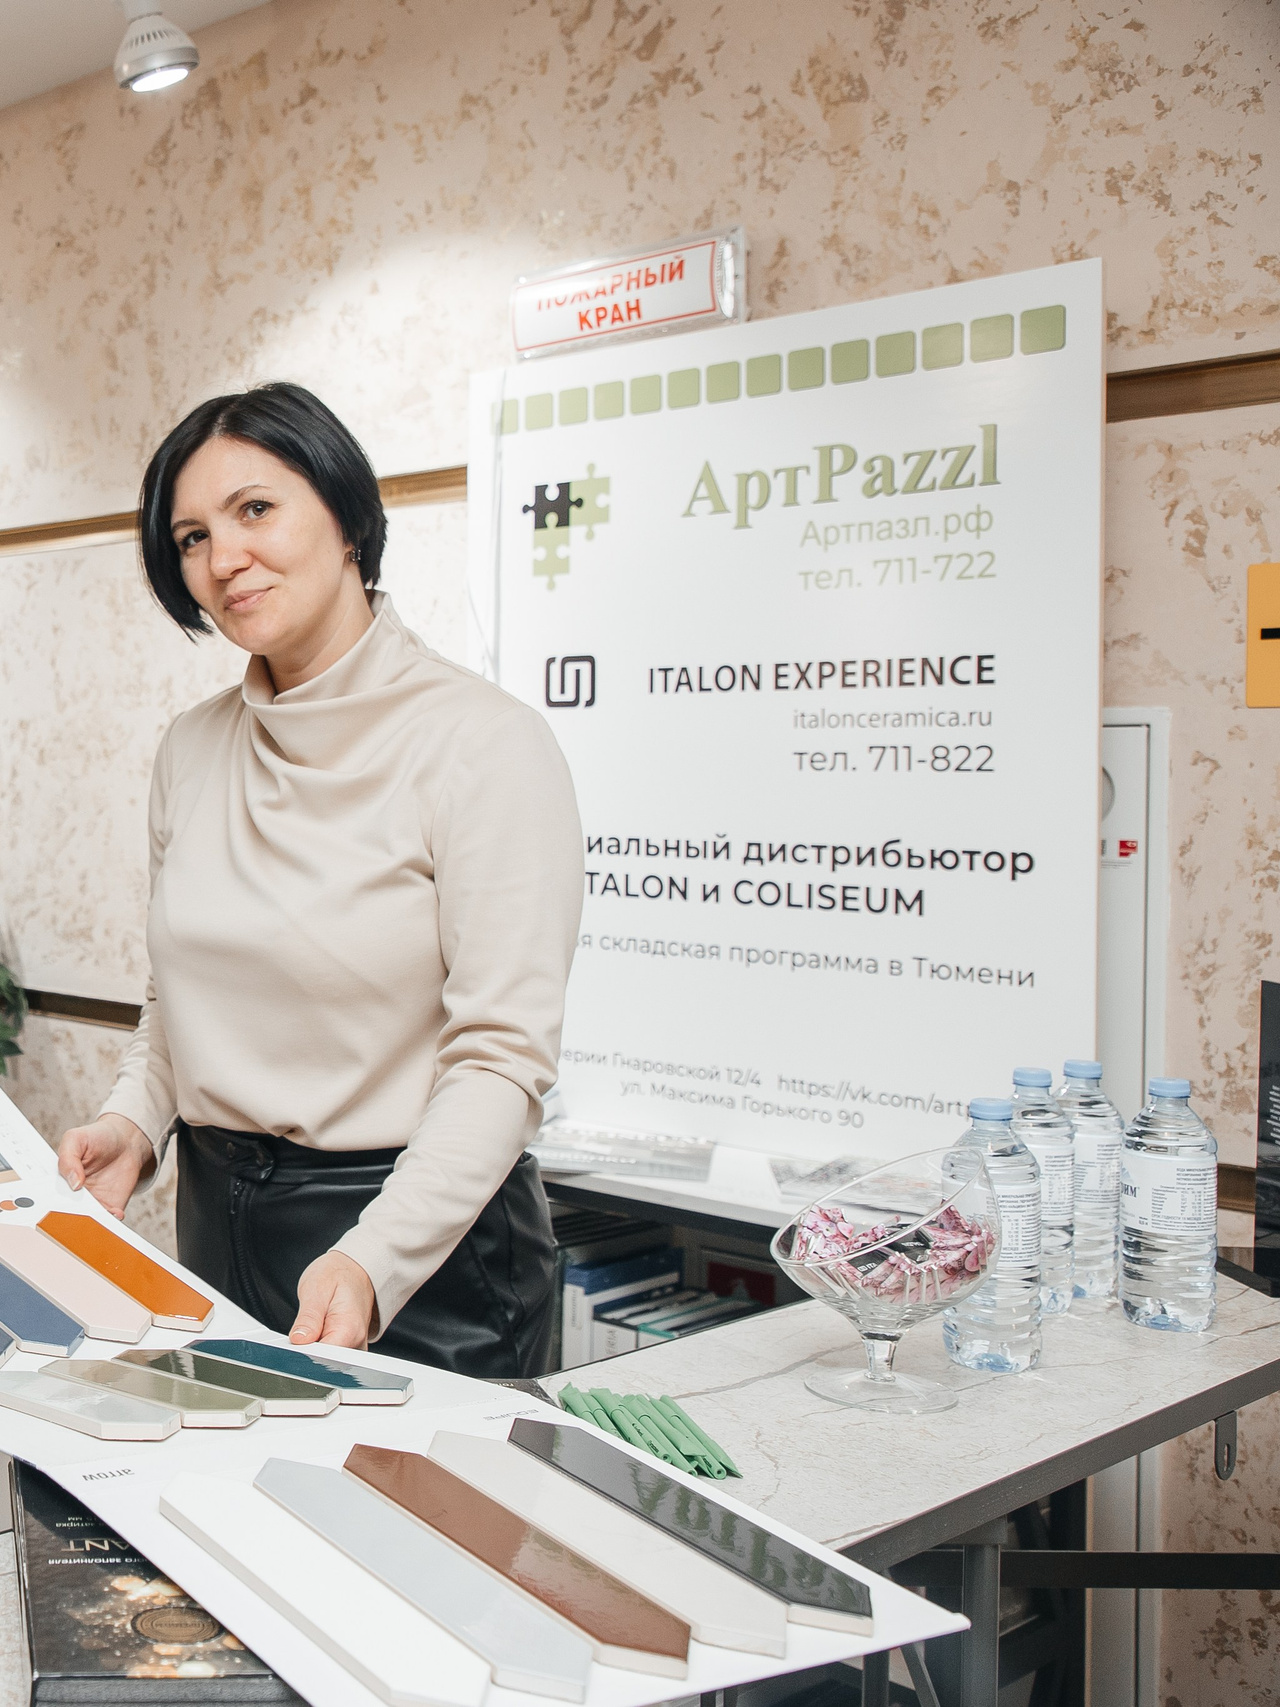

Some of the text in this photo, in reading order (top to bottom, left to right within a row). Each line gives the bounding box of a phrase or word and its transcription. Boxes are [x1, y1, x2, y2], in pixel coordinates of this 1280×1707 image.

[577, 298, 642, 332] КРАН
[798, 503, 995, 552] Артпазл.рф
[797, 550, 998, 591] тел. 711-722
[648, 653, 996, 694] ITALON EXPERIENCE
[792, 706, 993, 729] italonceramica.ru
[793, 745, 995, 773] тел. 711-822
[586, 832, 1035, 882] иальный дистрибьютор
[585, 871, 925, 916] TALON и COLISEUM
[599, 934, 721, 960] складская
[728, 945, 880, 975] программа
[888, 959, 904, 977] в
[911, 956, 1036, 989] Тюмени
[561, 1049, 608, 1069] ерии
[612, 1052, 721, 1081] Гнаровской
[724, 1066, 763, 1088] 12/4
[620, 1080, 865, 1129] ул. Максима Горького 90
[81, 1467, 136, 1482] arrow
[60, 1538, 130, 1552] ANT
